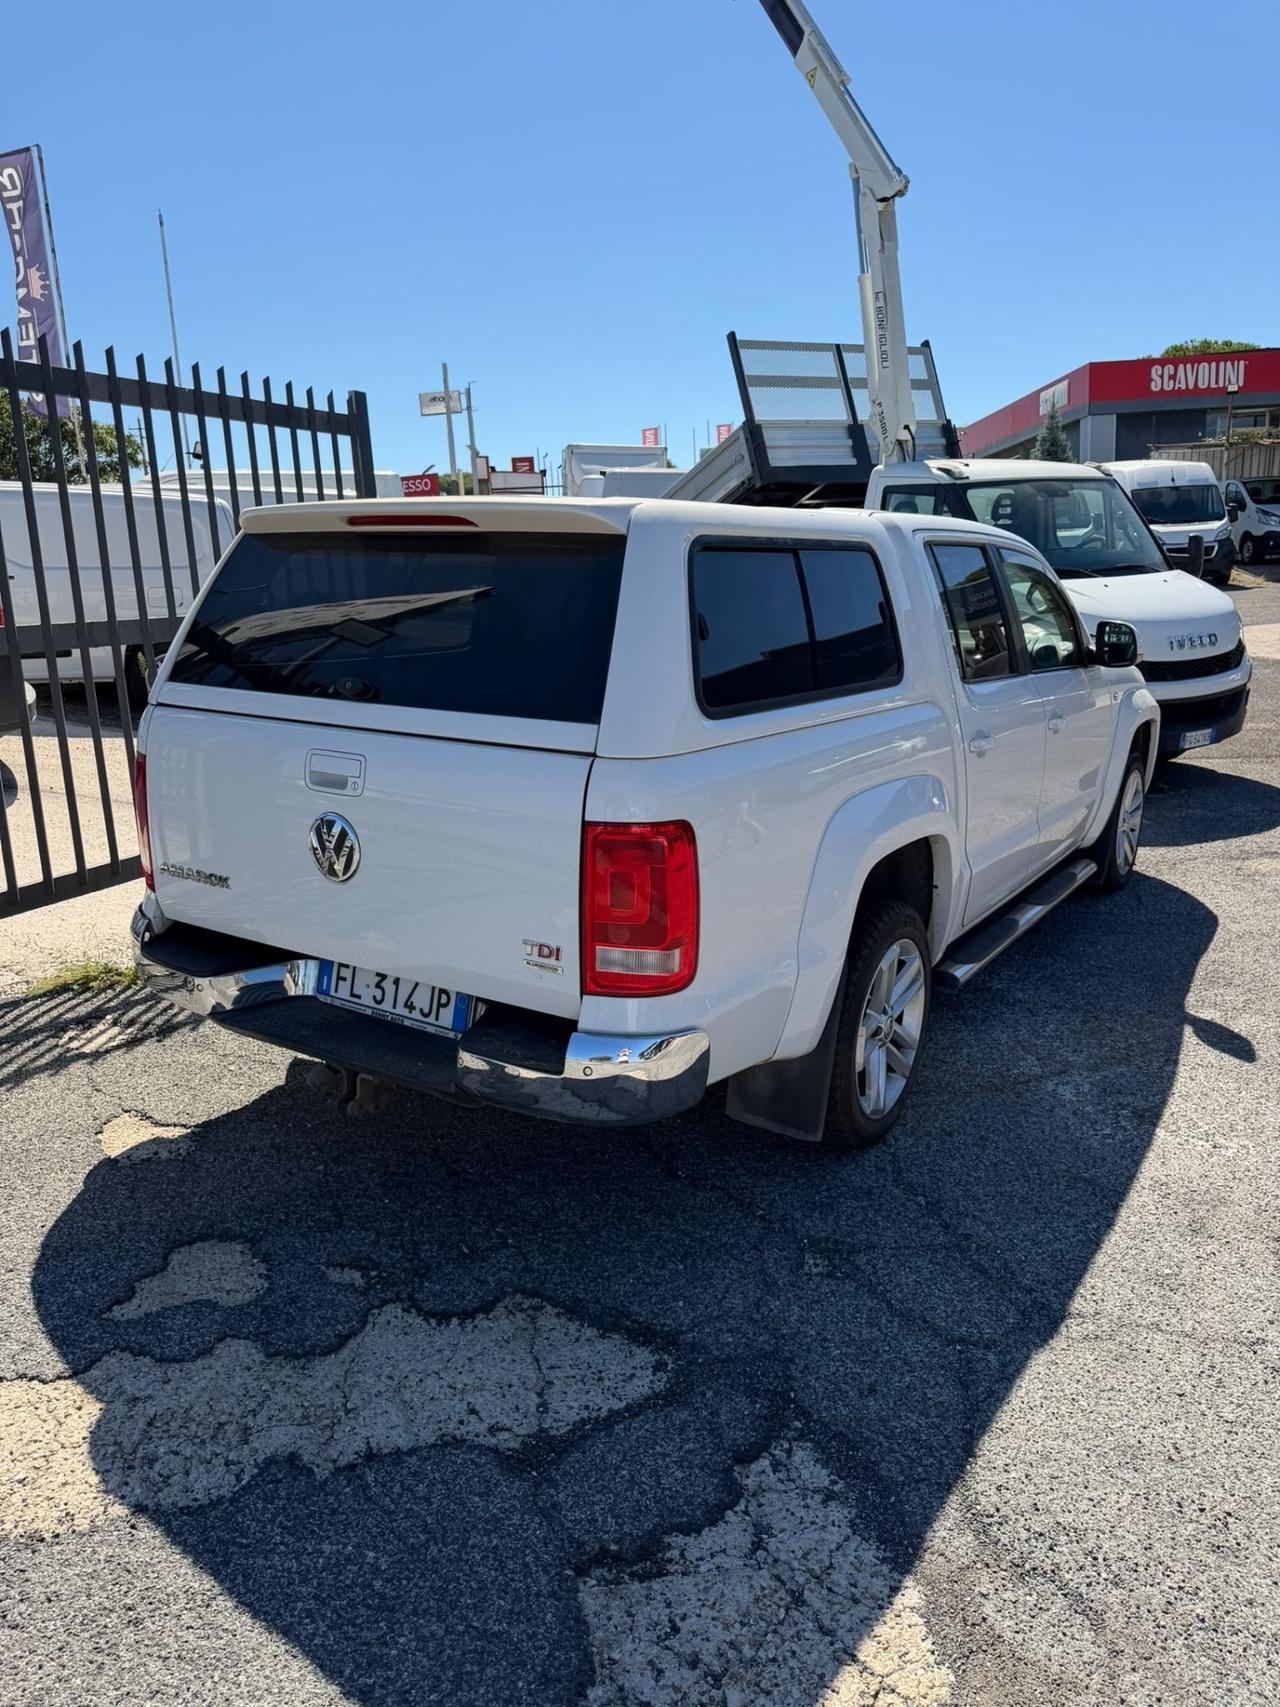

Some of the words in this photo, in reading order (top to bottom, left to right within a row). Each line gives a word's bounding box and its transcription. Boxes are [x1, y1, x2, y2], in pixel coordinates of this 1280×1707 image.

[1150, 360, 1245, 392] SCAVOLINI
[1168, 632, 1218, 652] IVECO
[159, 862, 232, 889] AMAROK
[521, 939, 563, 961] TDI
